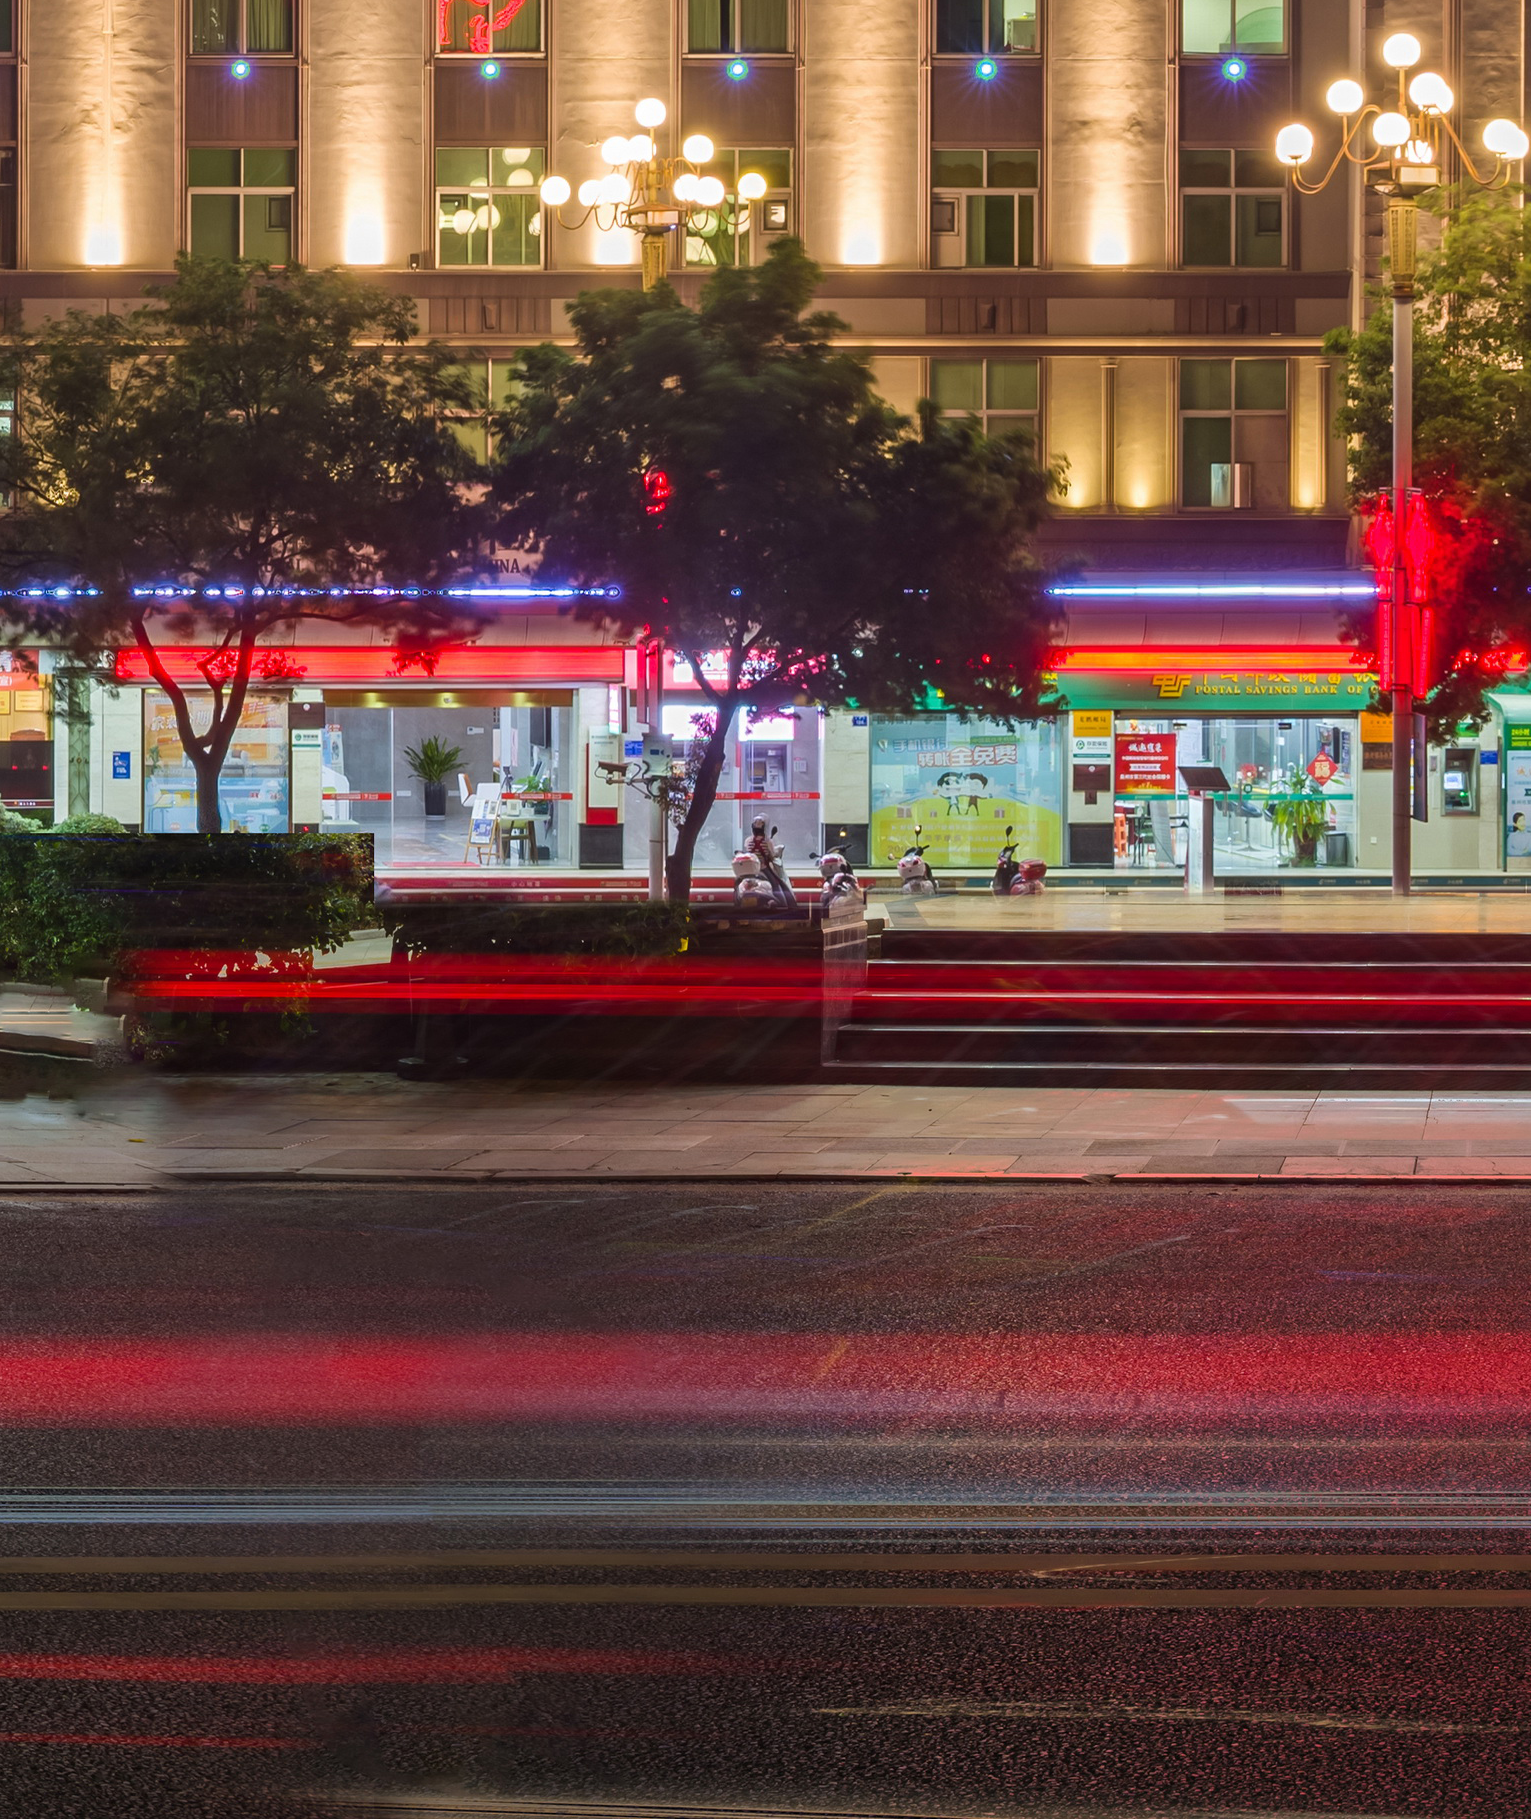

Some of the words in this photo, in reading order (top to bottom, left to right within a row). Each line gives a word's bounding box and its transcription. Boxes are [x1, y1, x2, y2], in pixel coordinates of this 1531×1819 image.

[1195, 684, 1241, 695] POSTAL
[1246, 684, 1298, 695] SAVINGS
[1304, 684, 1338, 695] BANK
[1347, 684, 1363, 695] OF
